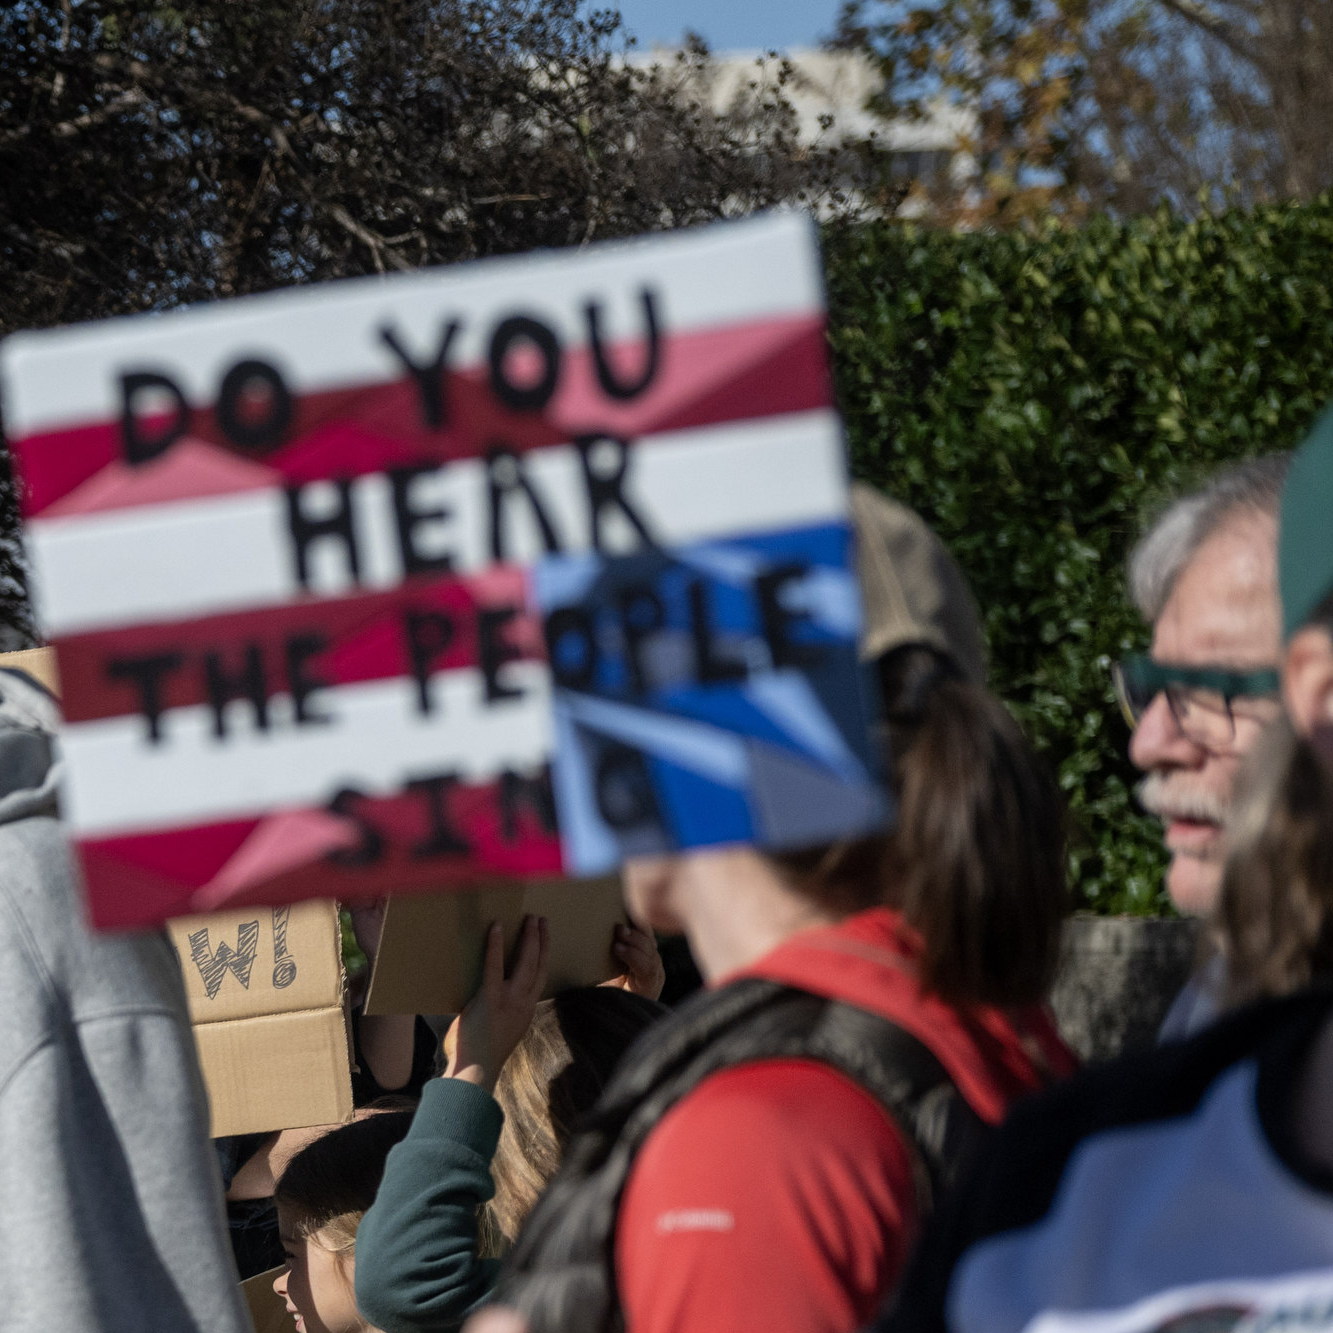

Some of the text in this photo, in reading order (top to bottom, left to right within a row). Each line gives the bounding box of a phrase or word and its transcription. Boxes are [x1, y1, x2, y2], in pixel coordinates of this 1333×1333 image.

[114, 283, 665, 470] DO YOU
[282, 428, 665, 592] HEAR
[106, 558, 812, 750] THE PEOPLE
[329, 733, 655, 869] SING
